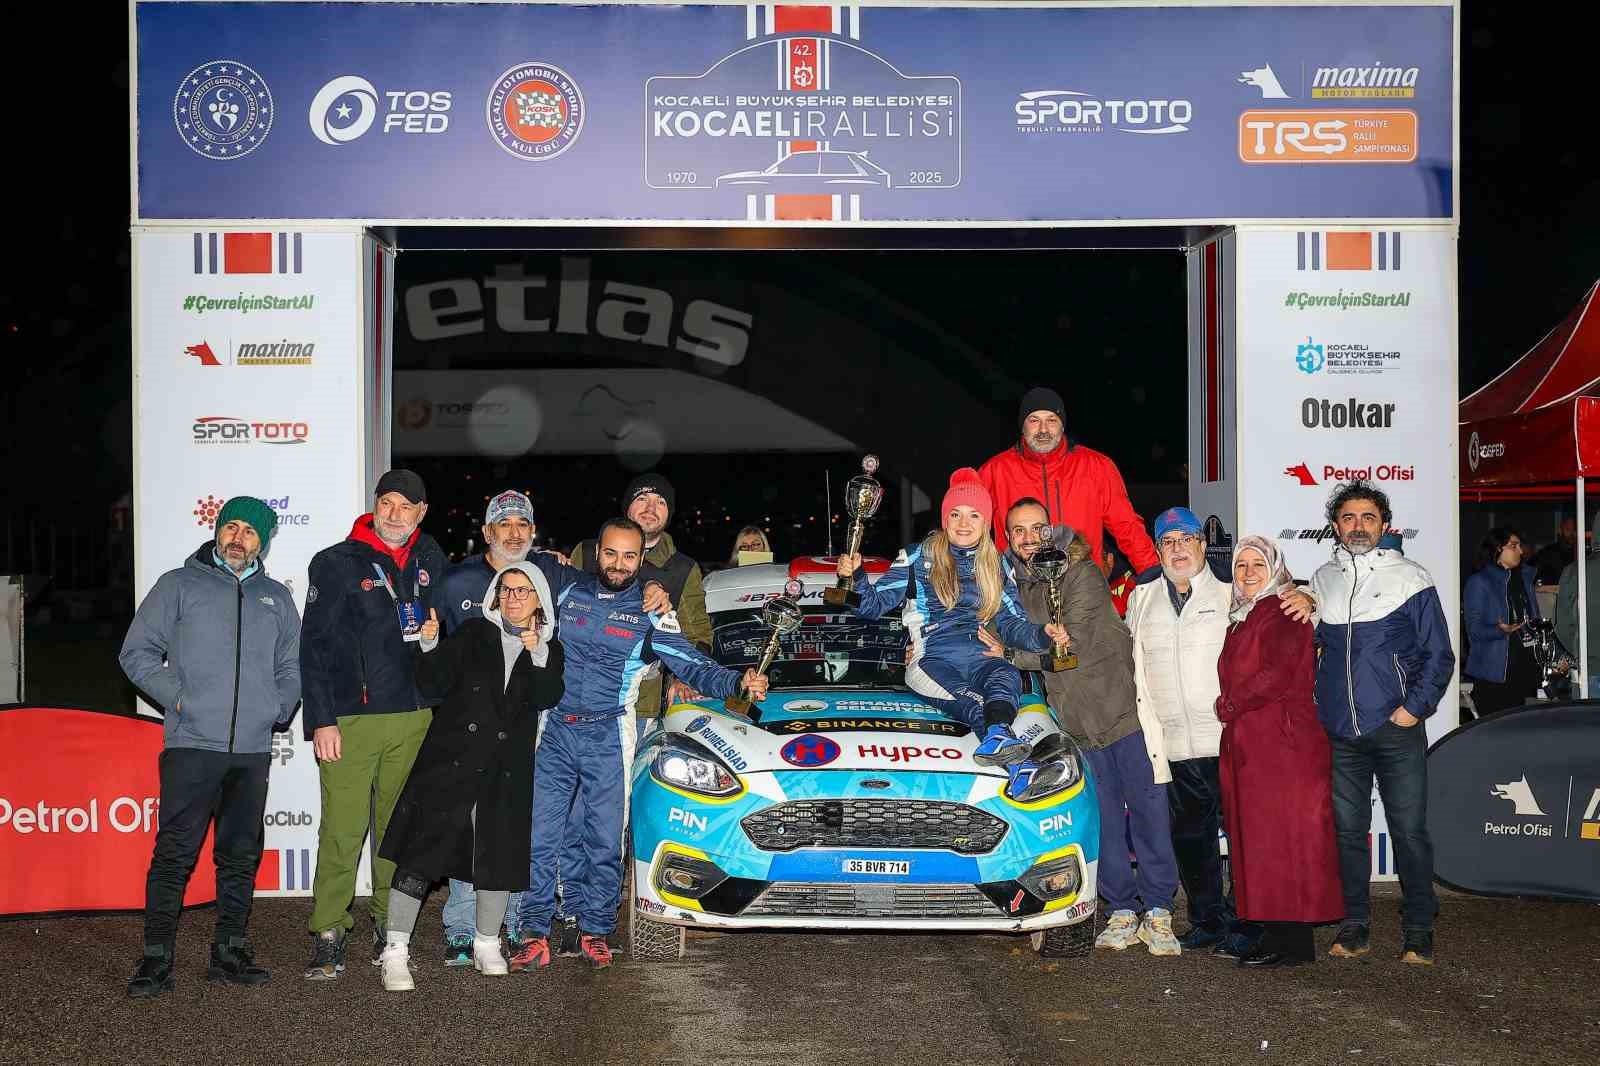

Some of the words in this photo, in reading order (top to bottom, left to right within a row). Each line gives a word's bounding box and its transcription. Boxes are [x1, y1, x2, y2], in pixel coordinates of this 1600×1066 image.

[793, 45, 812, 57] 42.
[1312, 61, 1419, 87] maxima
[385, 90, 452, 110] TOS
[736, 94, 847, 108] BÜYÜKŞEHİR
[383, 113, 448, 133] FED
[1246, 120, 1349, 155] TRS
[667, 171, 697, 184] 1970
[909, 171, 942, 184] 2025
[238, 339, 315, 357] maxima
[1302, 398, 1396, 428] Otokar
[1323, 465, 1371, 481] Petrol
[1376, 465, 1415, 481] Ofisi
[816, 720, 921, 730] BINANCE
[857, 745, 963, 762] Hypco
[1484, 822, 1520, 835] Petrol
[1523, 823, 1553, 837] Ofisi
[850, 861, 863, 872] 35
[865, 861, 886, 873] BVR
[889, 862, 907, 874] 714
